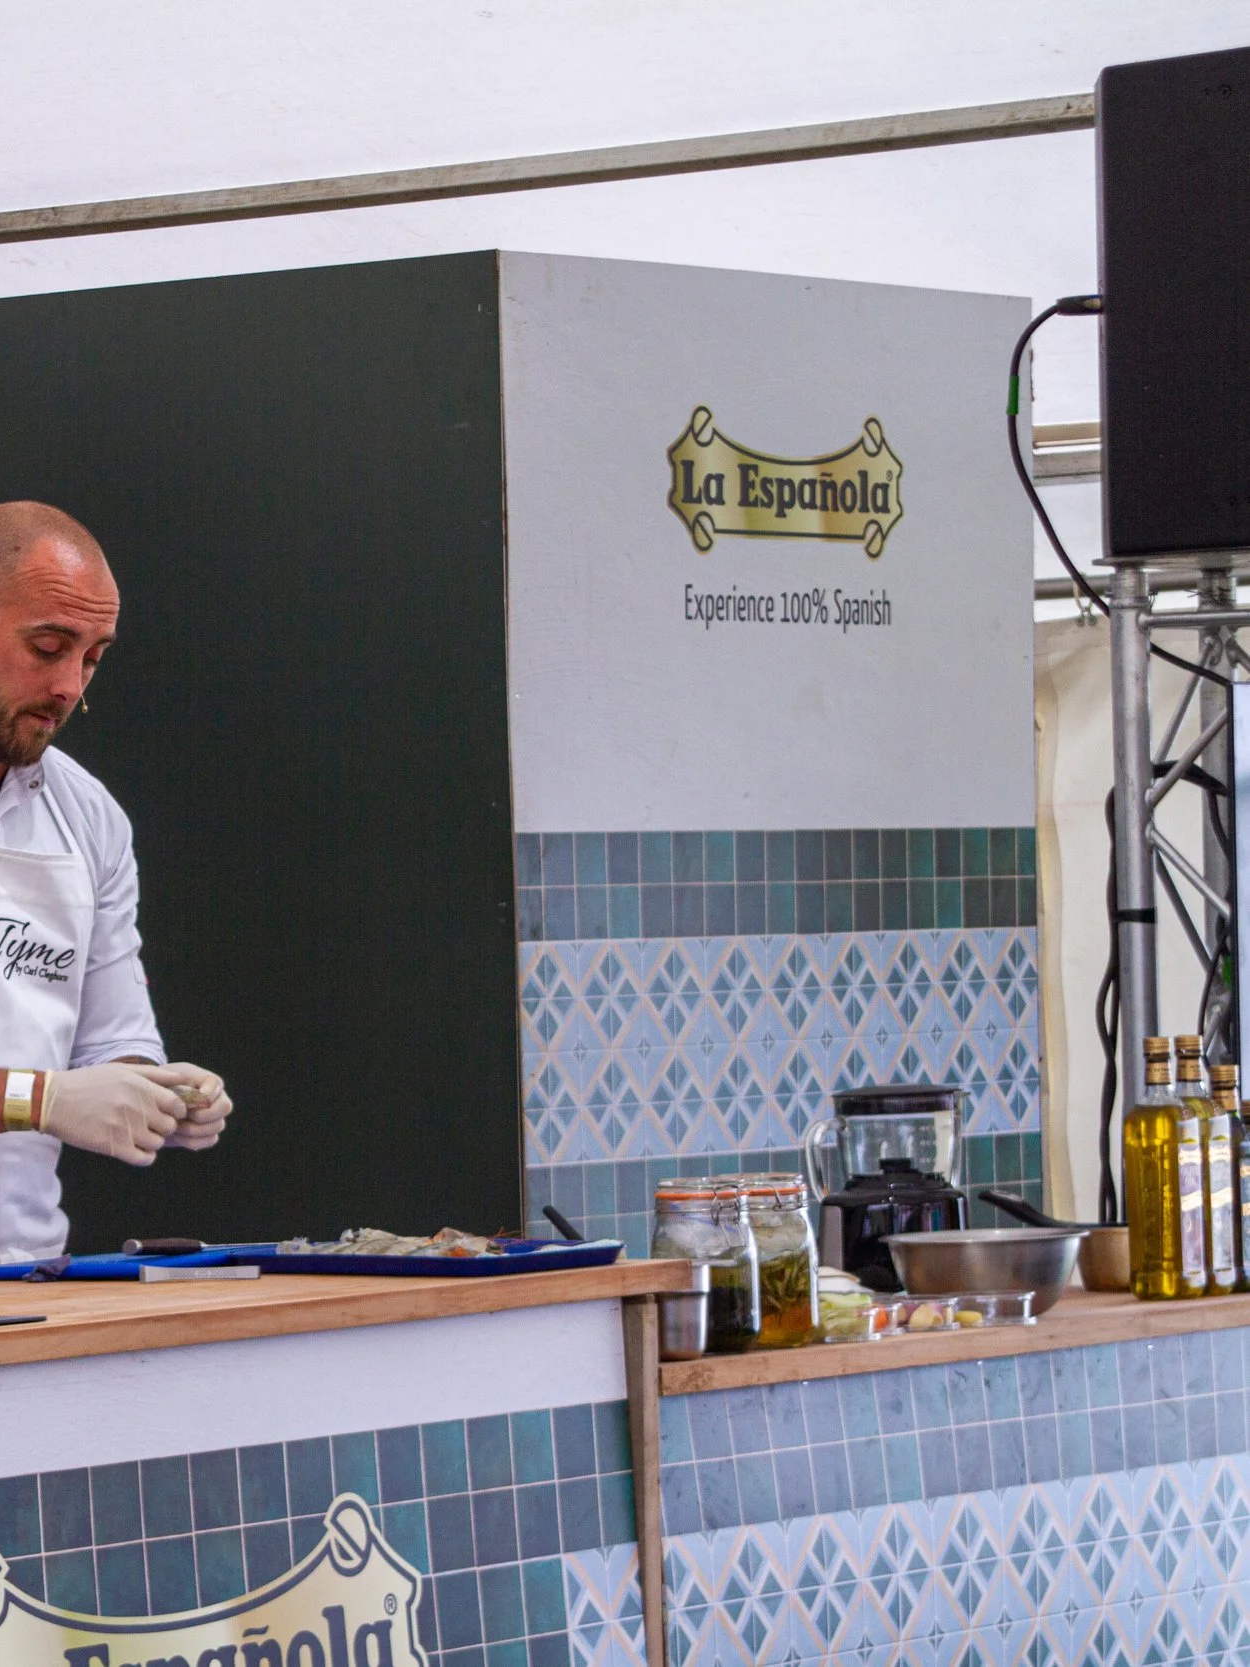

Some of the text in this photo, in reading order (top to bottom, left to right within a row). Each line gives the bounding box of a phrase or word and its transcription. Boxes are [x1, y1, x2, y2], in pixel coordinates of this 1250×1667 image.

[680, 459, 891, 518] La Española
[684, 583, 892, 634] Experience 100% Spanish
